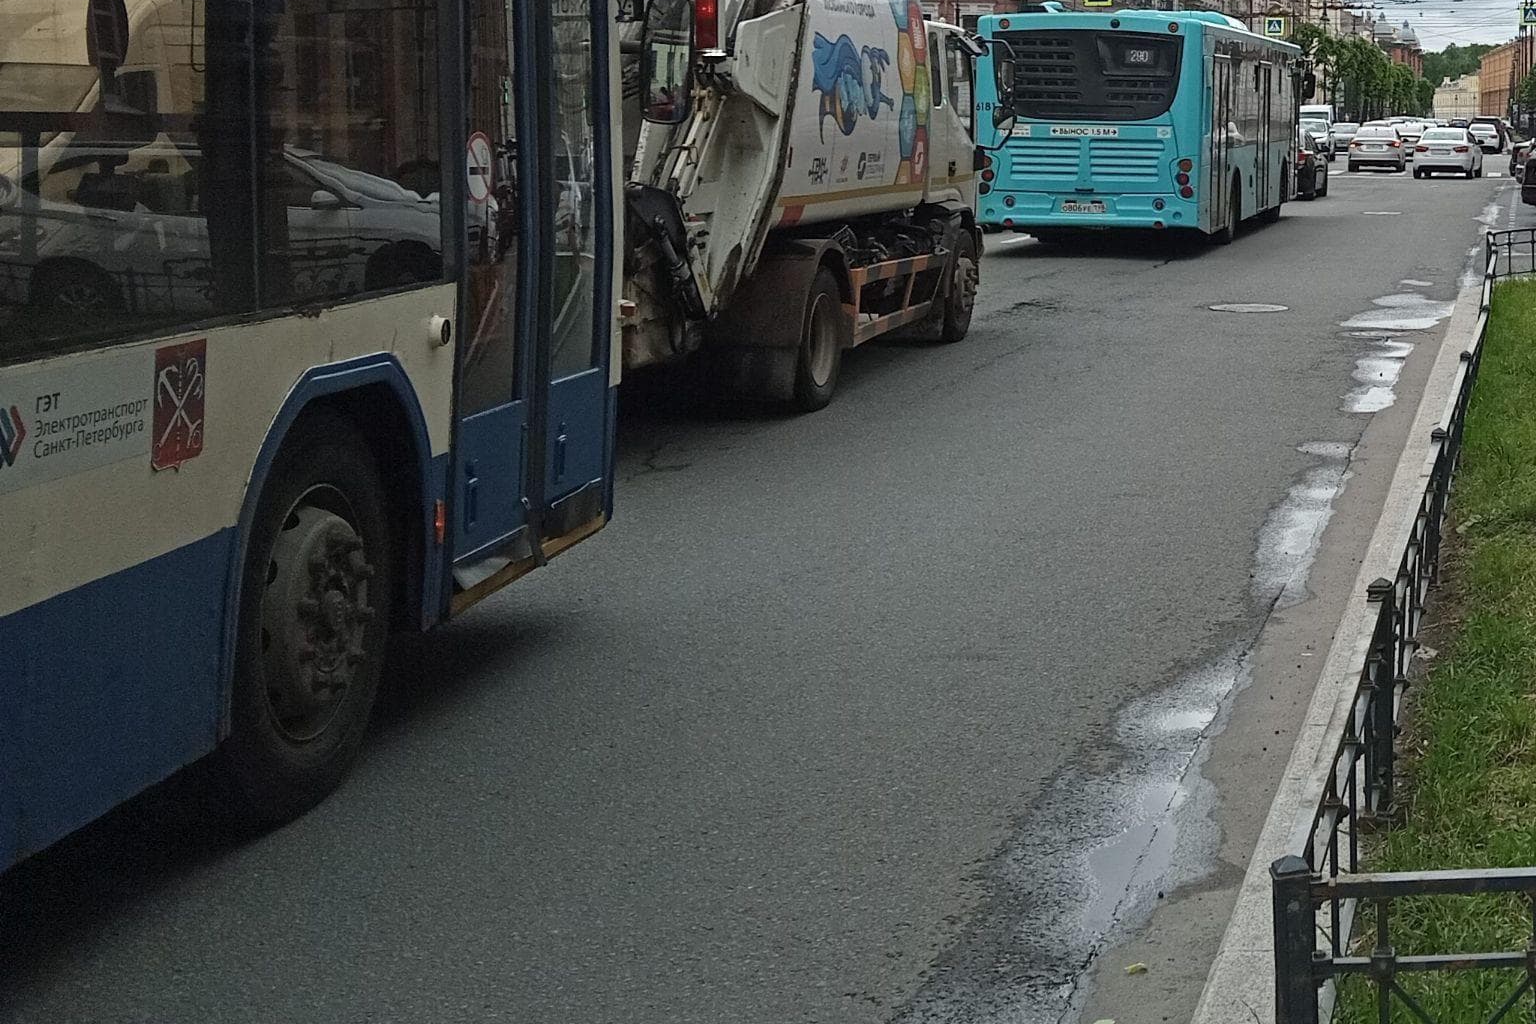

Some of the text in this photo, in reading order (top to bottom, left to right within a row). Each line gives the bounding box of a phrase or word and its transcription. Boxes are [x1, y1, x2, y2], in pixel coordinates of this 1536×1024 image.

[1060, 127, 1089, 135] ВЫНОС
[34, 398, 149, 438] Электротранспорт
[35, 392, 61, 414] ГЭТ
[33, 418, 144, 459] Санкт-Петербурга
